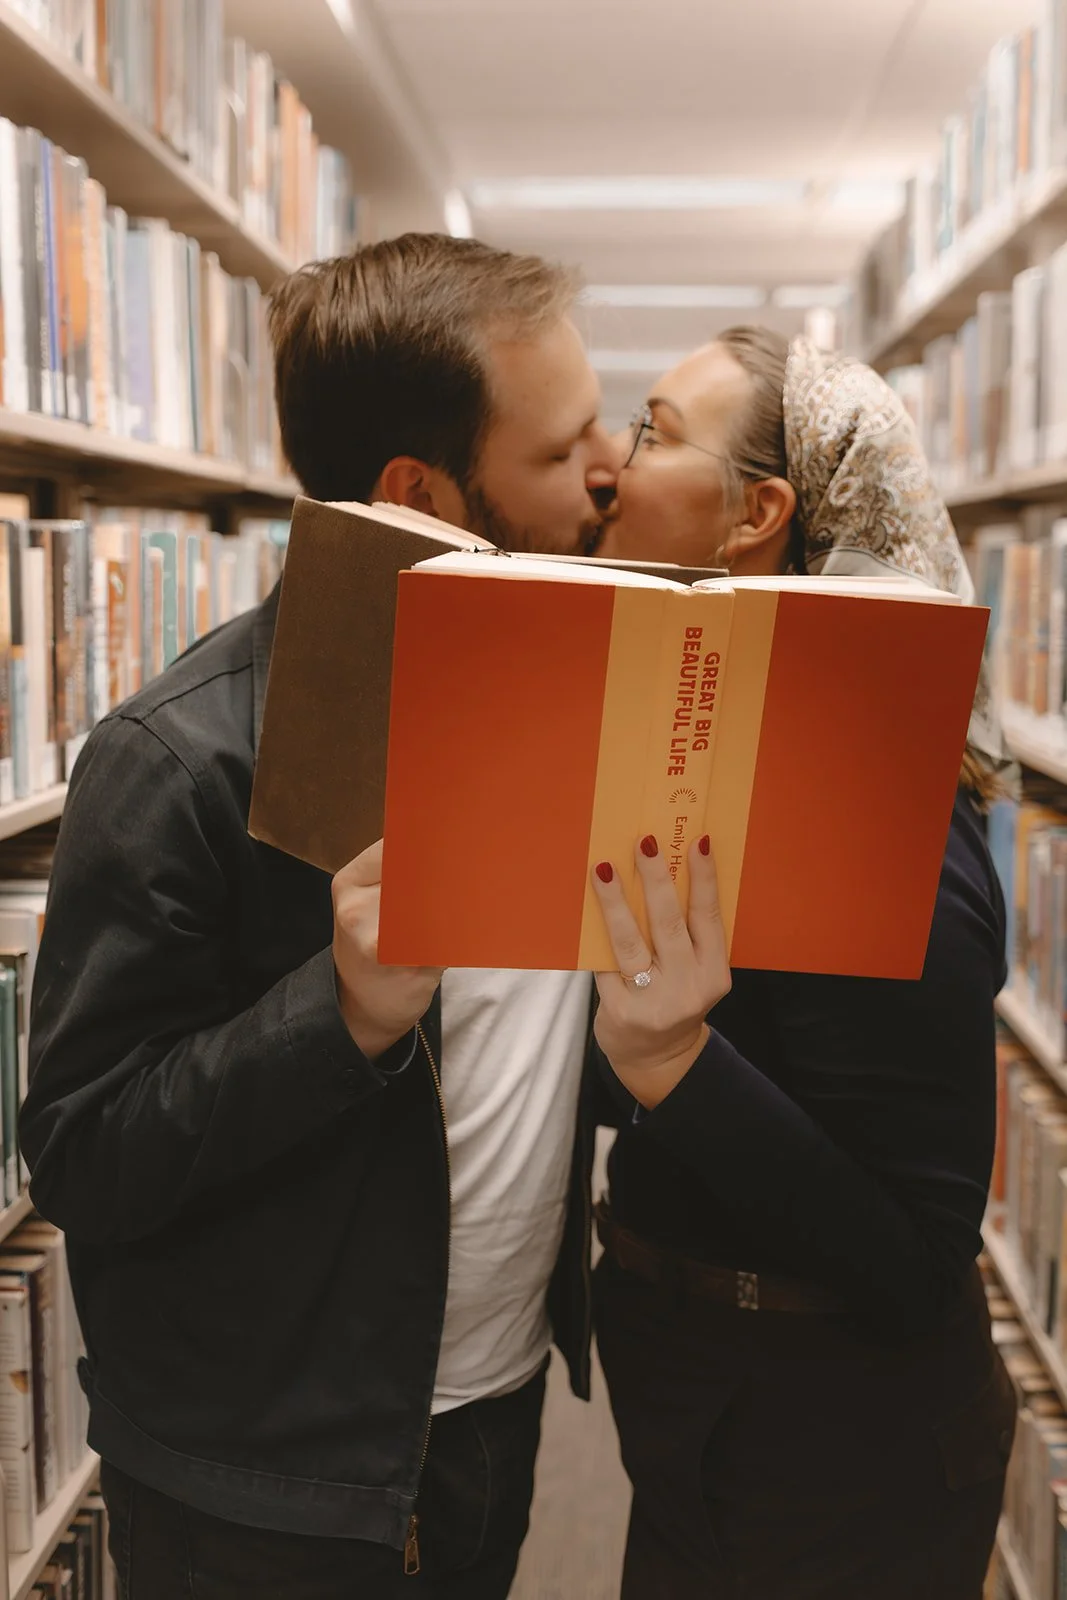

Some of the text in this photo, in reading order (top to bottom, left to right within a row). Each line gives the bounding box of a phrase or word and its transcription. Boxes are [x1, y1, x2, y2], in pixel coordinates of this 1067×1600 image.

[667, 627, 703, 776] BEAUTIFUL LIFE
[692, 652, 720, 751] GREAT BIG
[669, 816, 687, 885] Emily Hen
